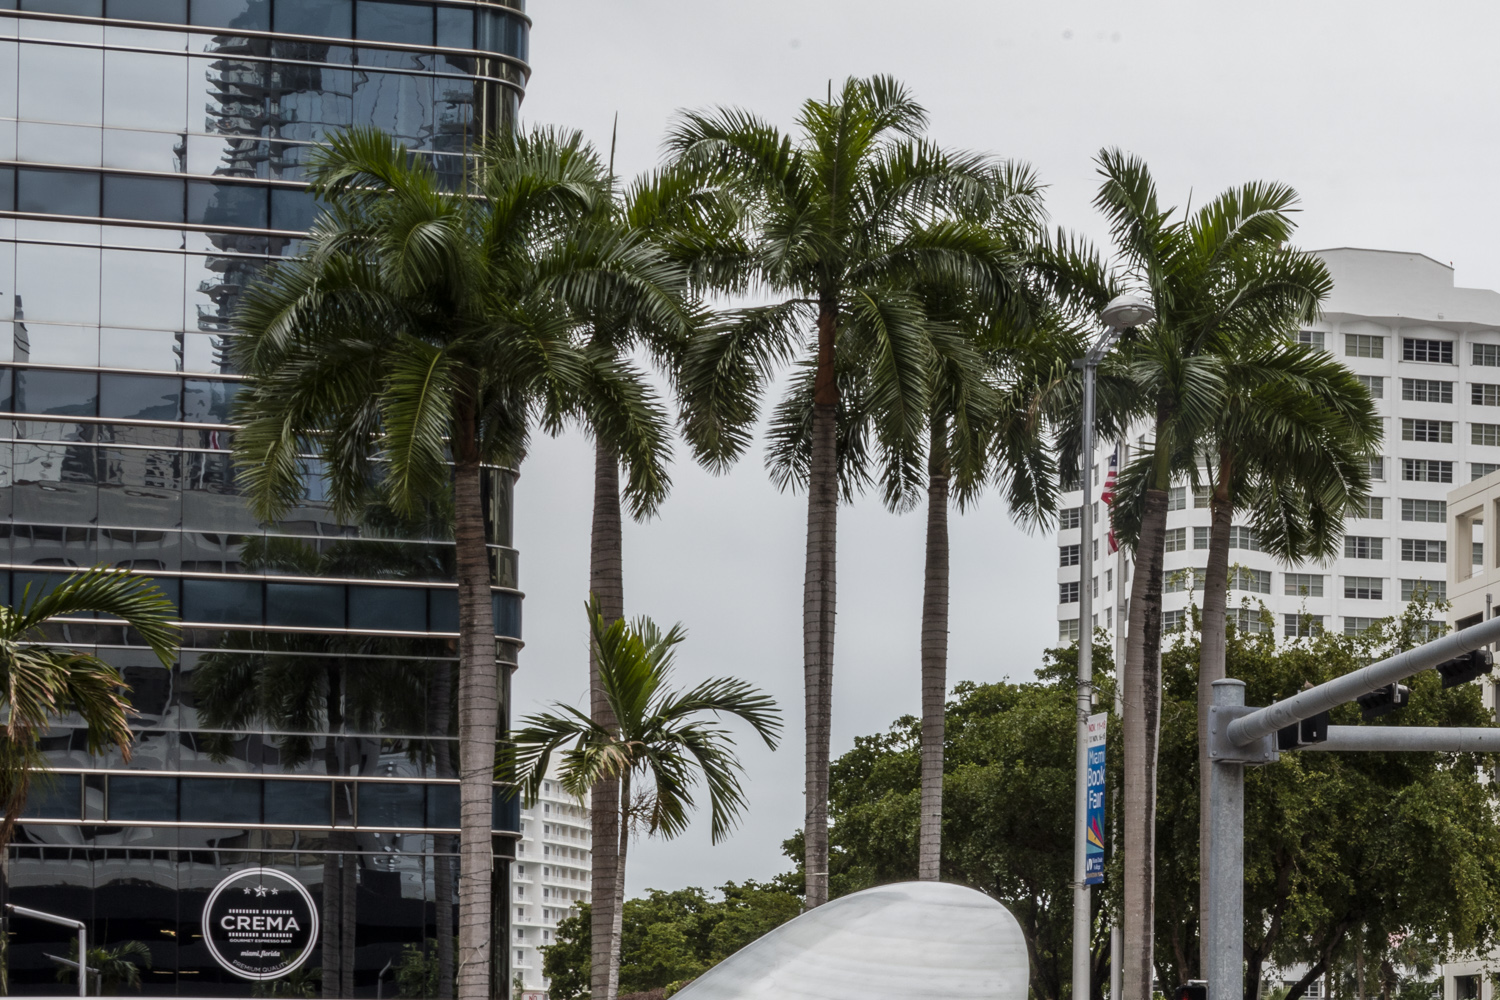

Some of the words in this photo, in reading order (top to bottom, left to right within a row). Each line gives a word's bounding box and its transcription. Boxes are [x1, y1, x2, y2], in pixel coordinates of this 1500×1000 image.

[1089, 750, 1105, 766] Miami
[1088, 766, 1105, 787] Book
[1089, 790, 1103, 810] Fair
[220, 915, 300, 931] CREMA
[233, 960, 261, 972] PREMIUM
[262, 960, 289, 972] QUALITY
